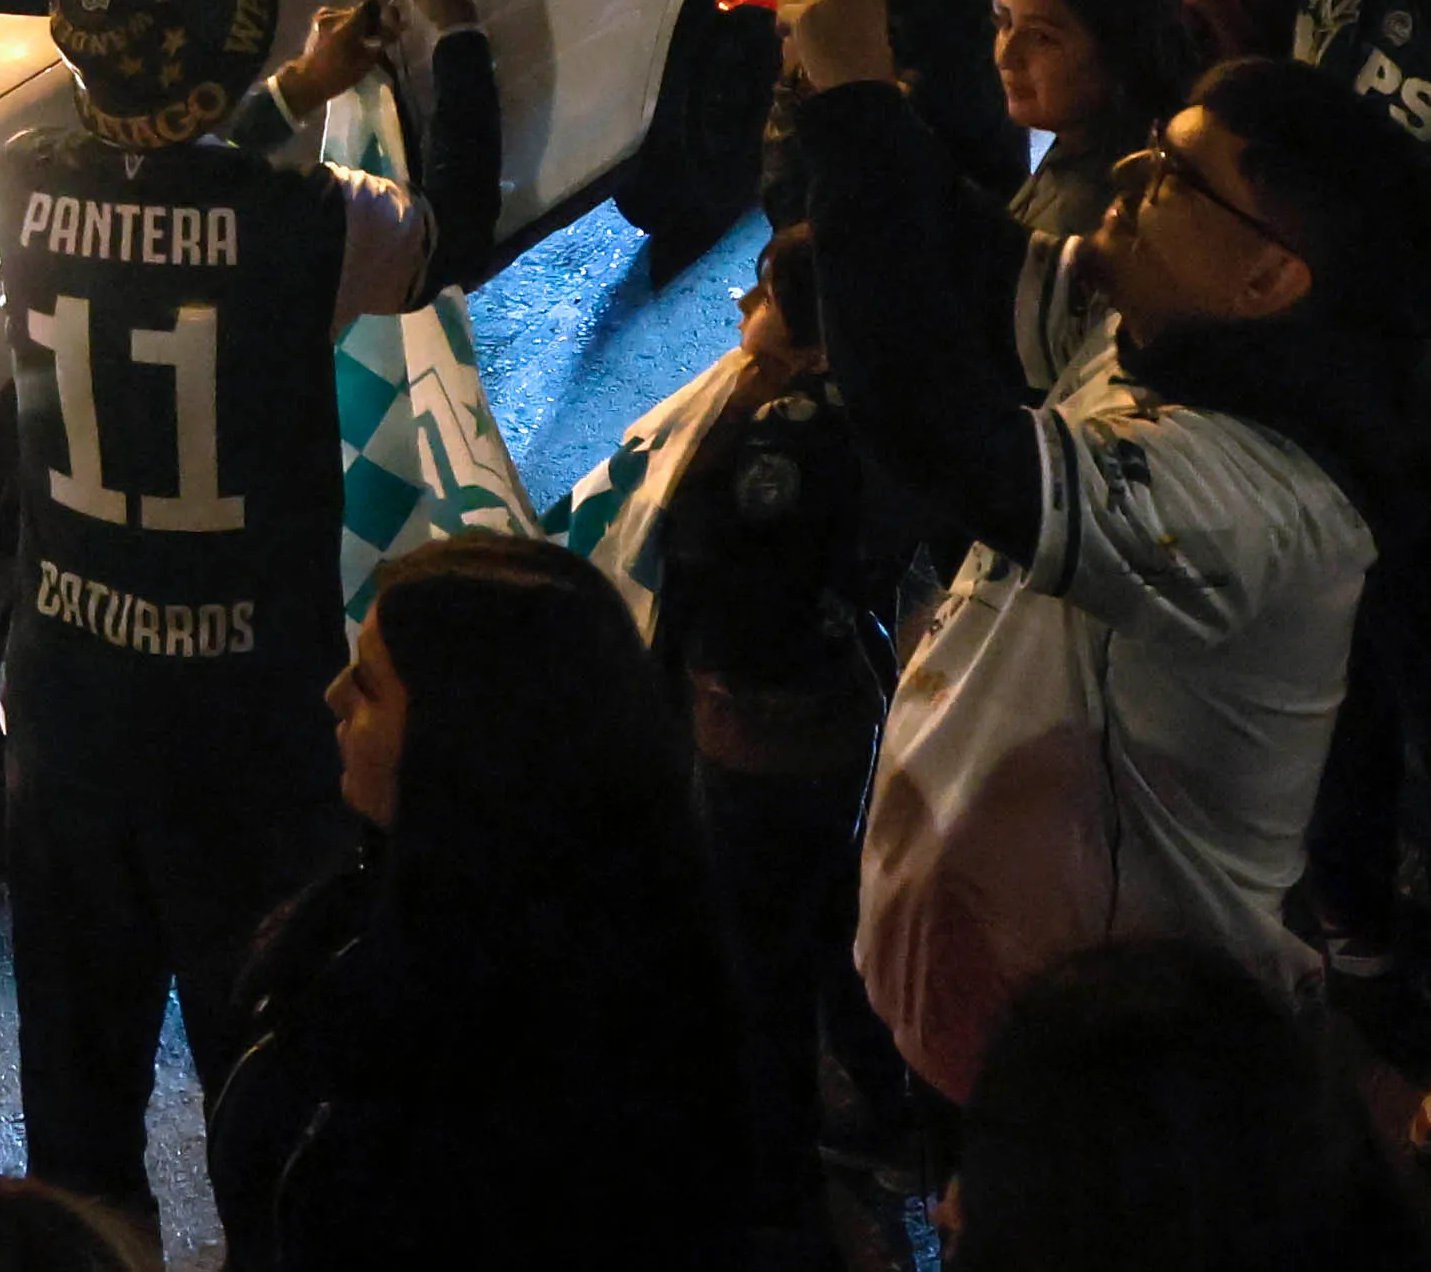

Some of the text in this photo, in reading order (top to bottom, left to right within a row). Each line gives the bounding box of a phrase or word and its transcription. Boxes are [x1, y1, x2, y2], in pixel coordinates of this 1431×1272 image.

[21, 192, 238, 267] PANTERA
[26, 293, 247, 534] 11
[36, 559, 256, 659] CATURROS
